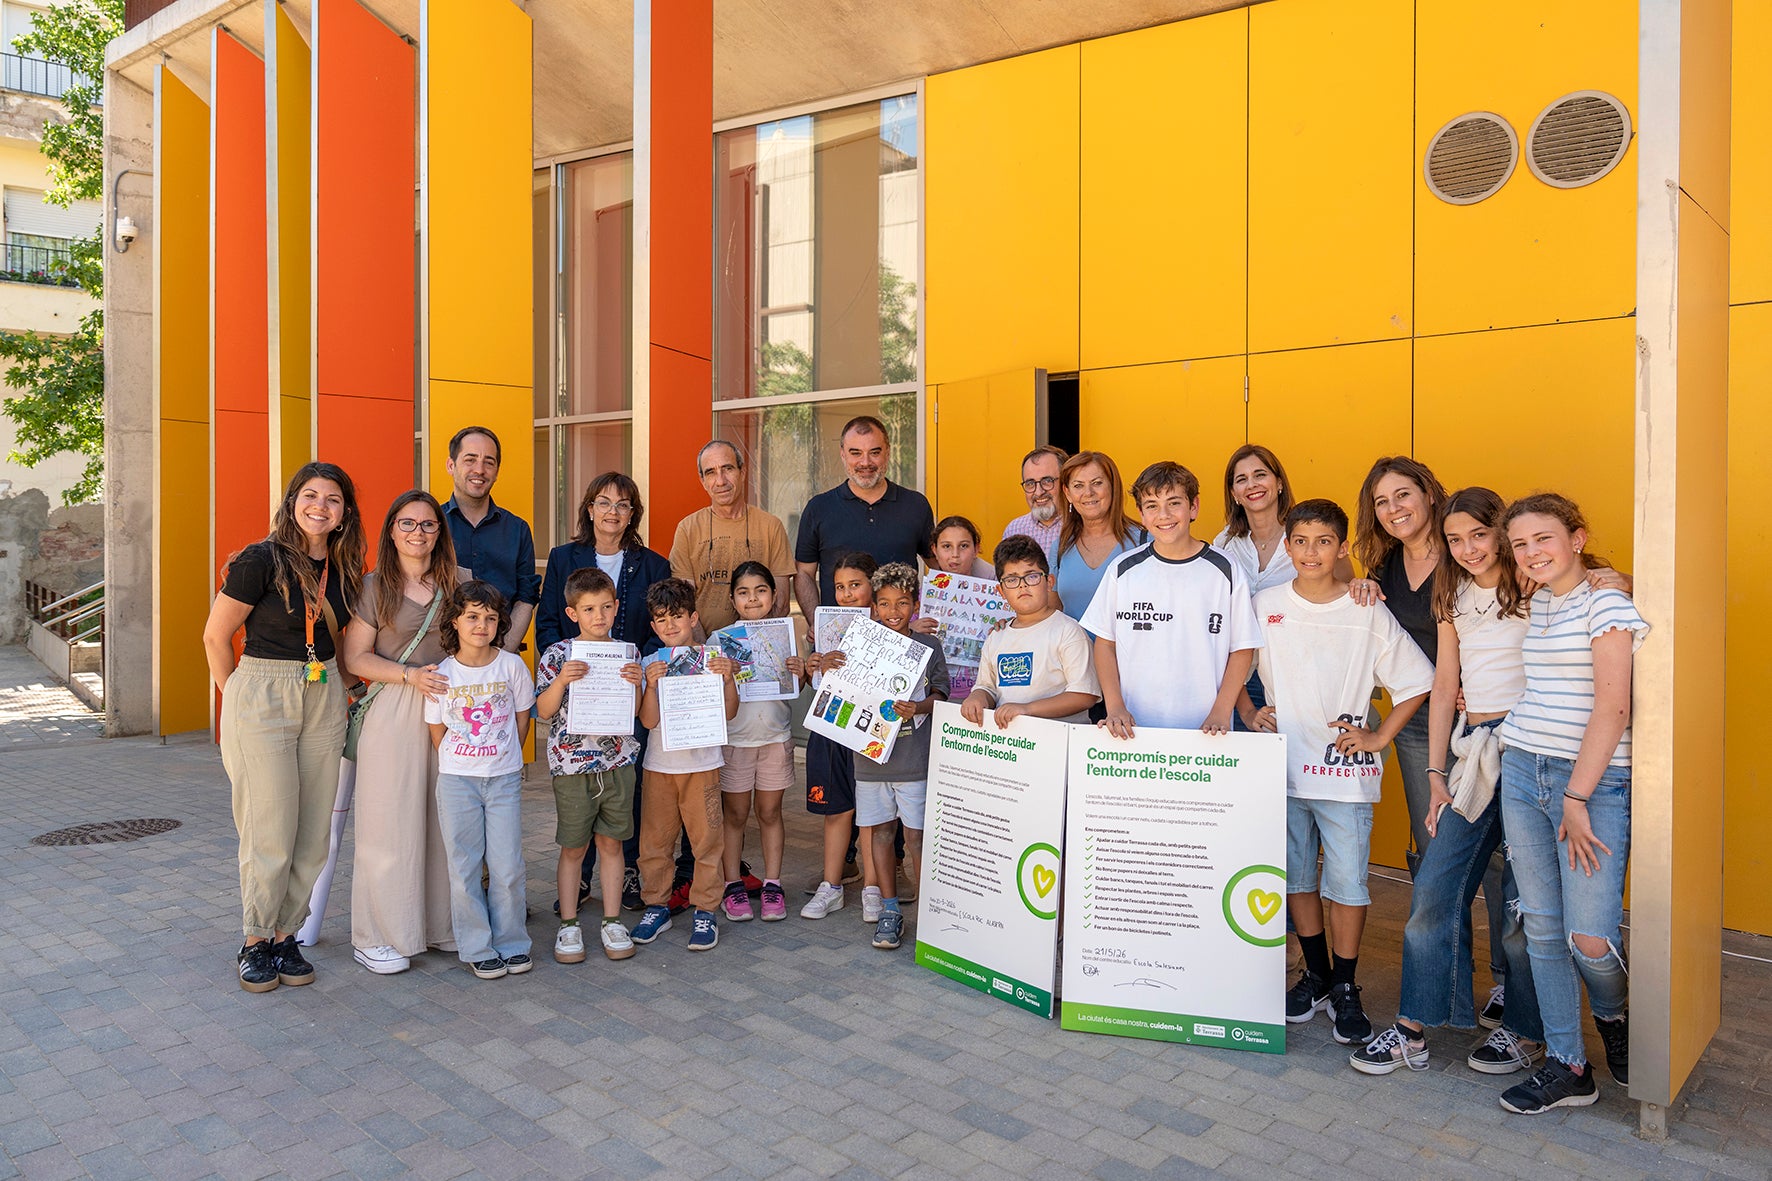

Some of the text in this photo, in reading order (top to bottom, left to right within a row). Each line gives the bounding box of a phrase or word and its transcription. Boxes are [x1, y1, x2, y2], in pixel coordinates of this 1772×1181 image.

[1133, 602, 1154, 610] FIFA
[1116, 612, 1173, 622] WORLD CUP
[942, 722, 1036, 750] Compromís per cuidar
[941, 736, 1017, 762] l'entorn de l'escola
[1087, 748, 1239, 767] Compromís per cuidar
[1087, 764, 1211, 782] l'entorn de l'escola
[1150, 1022, 1183, 1031] cuidem-la
